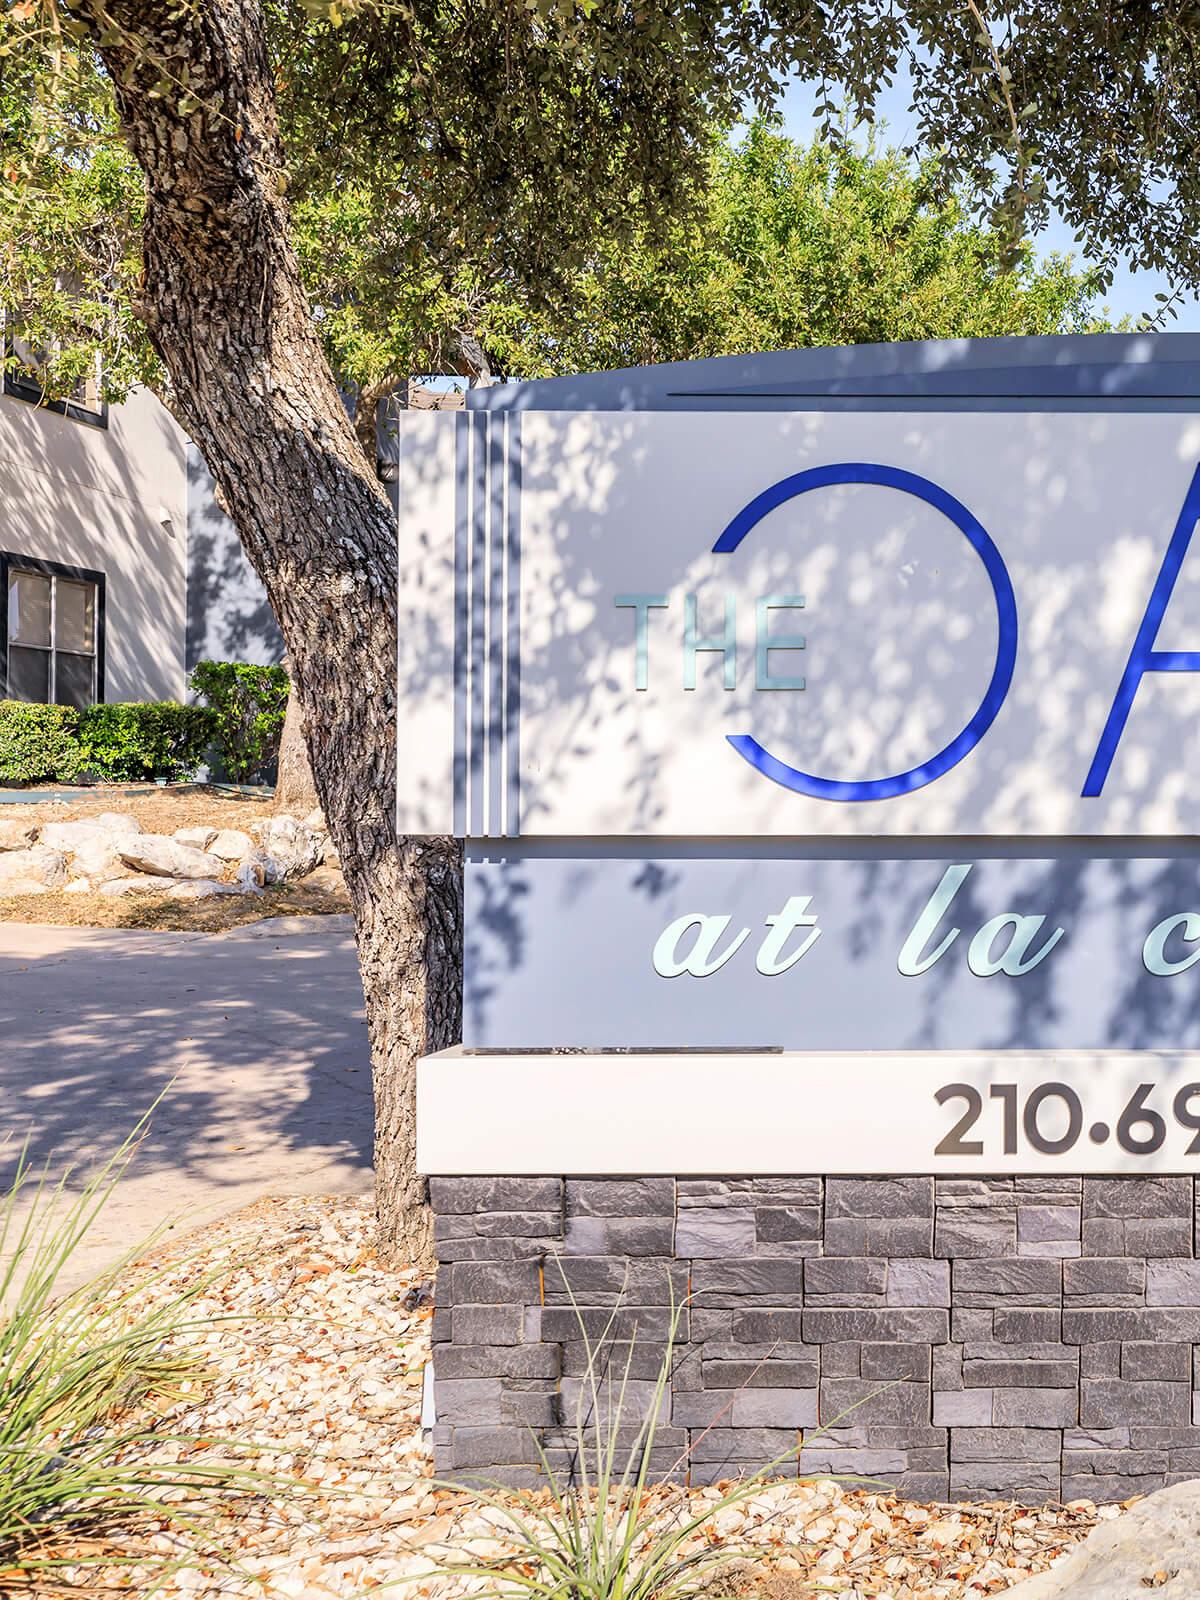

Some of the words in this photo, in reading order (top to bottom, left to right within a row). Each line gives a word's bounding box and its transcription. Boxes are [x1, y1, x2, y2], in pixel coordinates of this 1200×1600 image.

[614, 595, 806, 691] THE
[653, 895, 823, 978] at
[897, 863, 1065, 978] la
